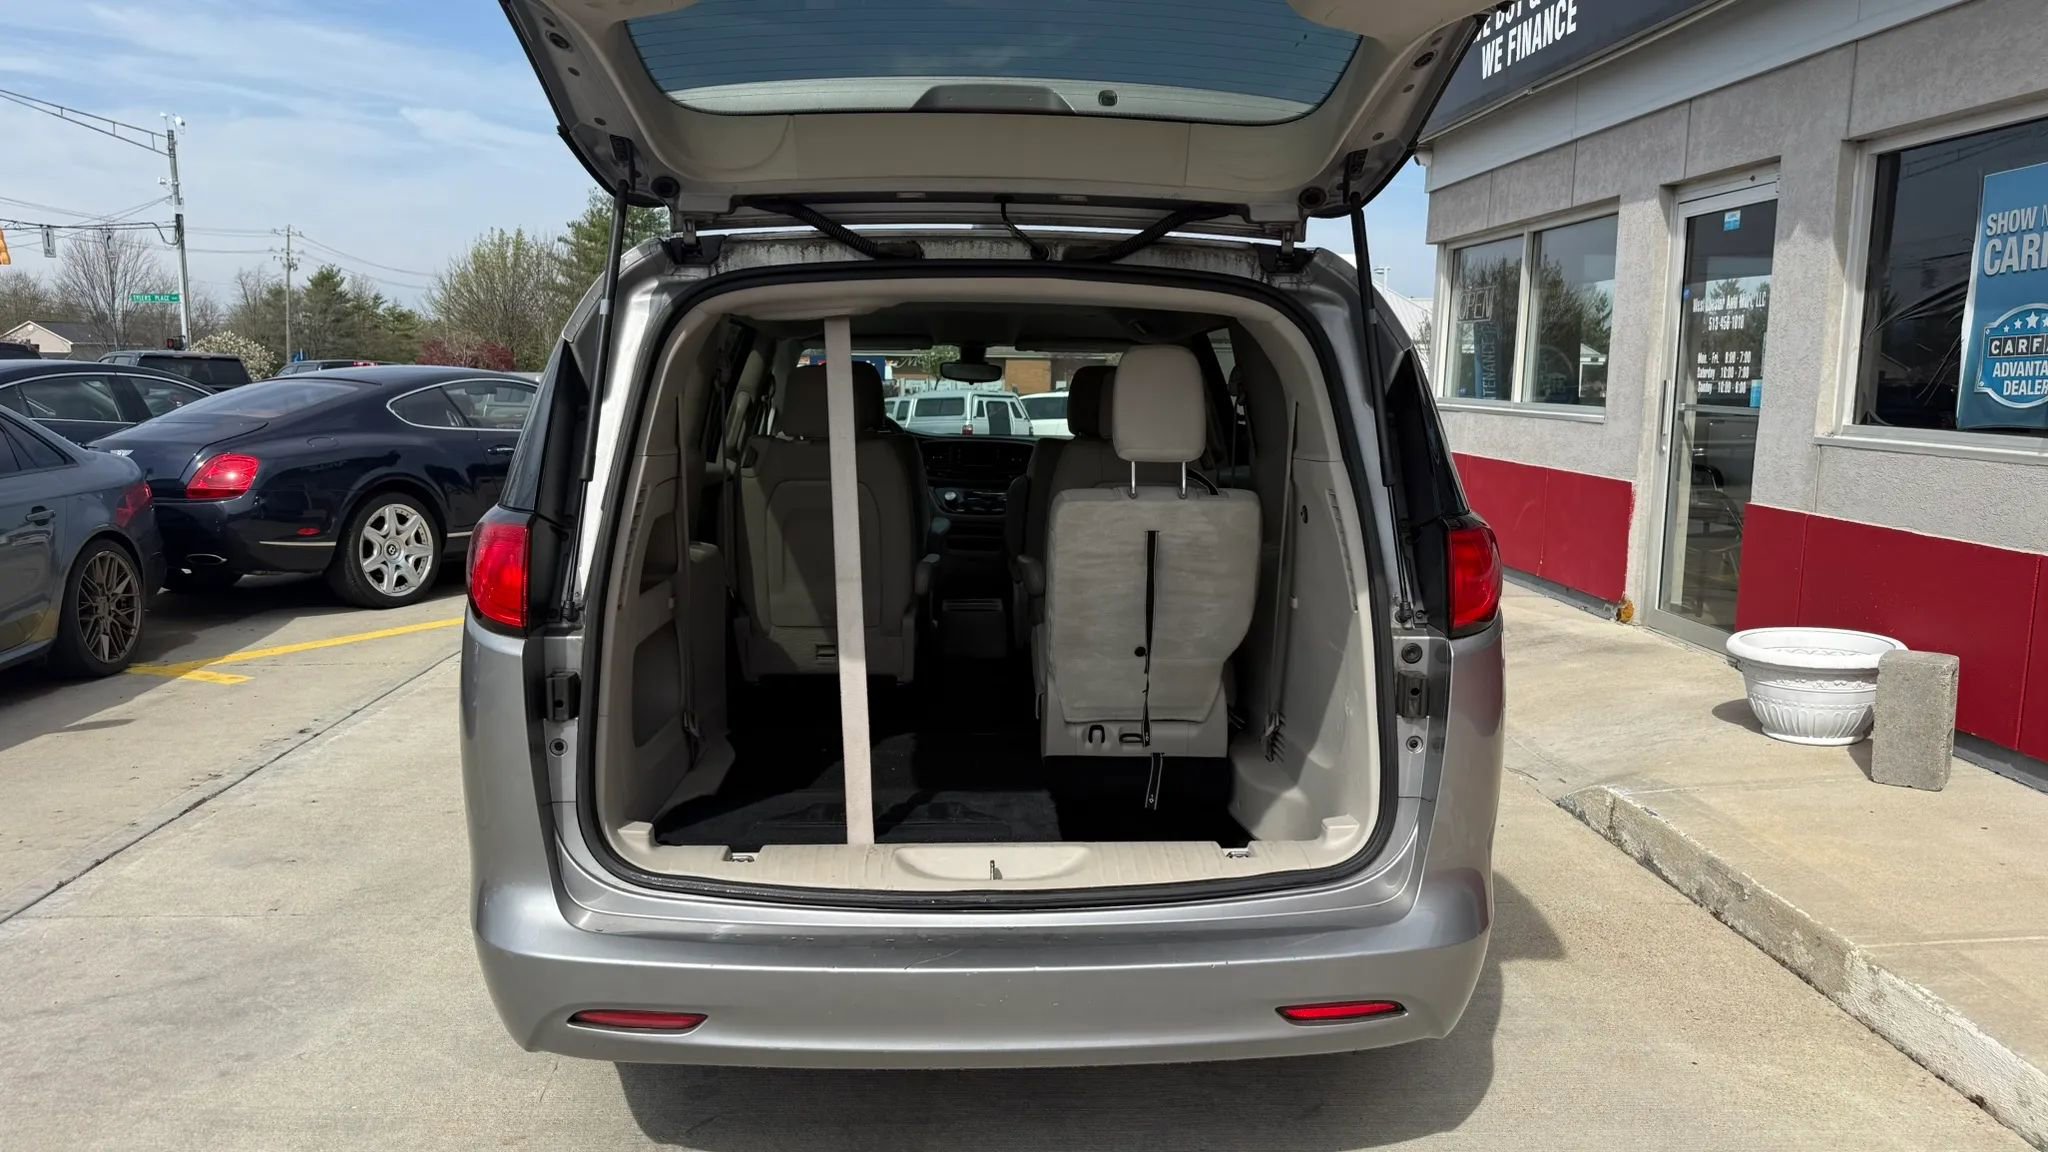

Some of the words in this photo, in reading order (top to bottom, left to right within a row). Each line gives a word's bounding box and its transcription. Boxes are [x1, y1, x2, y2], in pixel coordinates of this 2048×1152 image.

[1482, 35, 1503, 80] WE
[1507, 0, 1577, 67] FINANCE
[1986, 206, 2037, 237] SHOW
[1459, 289, 1496, 320] OPEN
[1756, 291, 1766, 307] LLC
[1991, 337, 2048, 355] CARF
[1740, 351, 1752, 364] 7:00
[1697, 366, 1716, 380] Saturday
[1738, 366, 1750, 379] 7:00
[1992, 359, 2048, 378] ADVANTA
[1697, 381, 1713, 394] Sunday
[2003, 379, 2048, 396] DEALER
